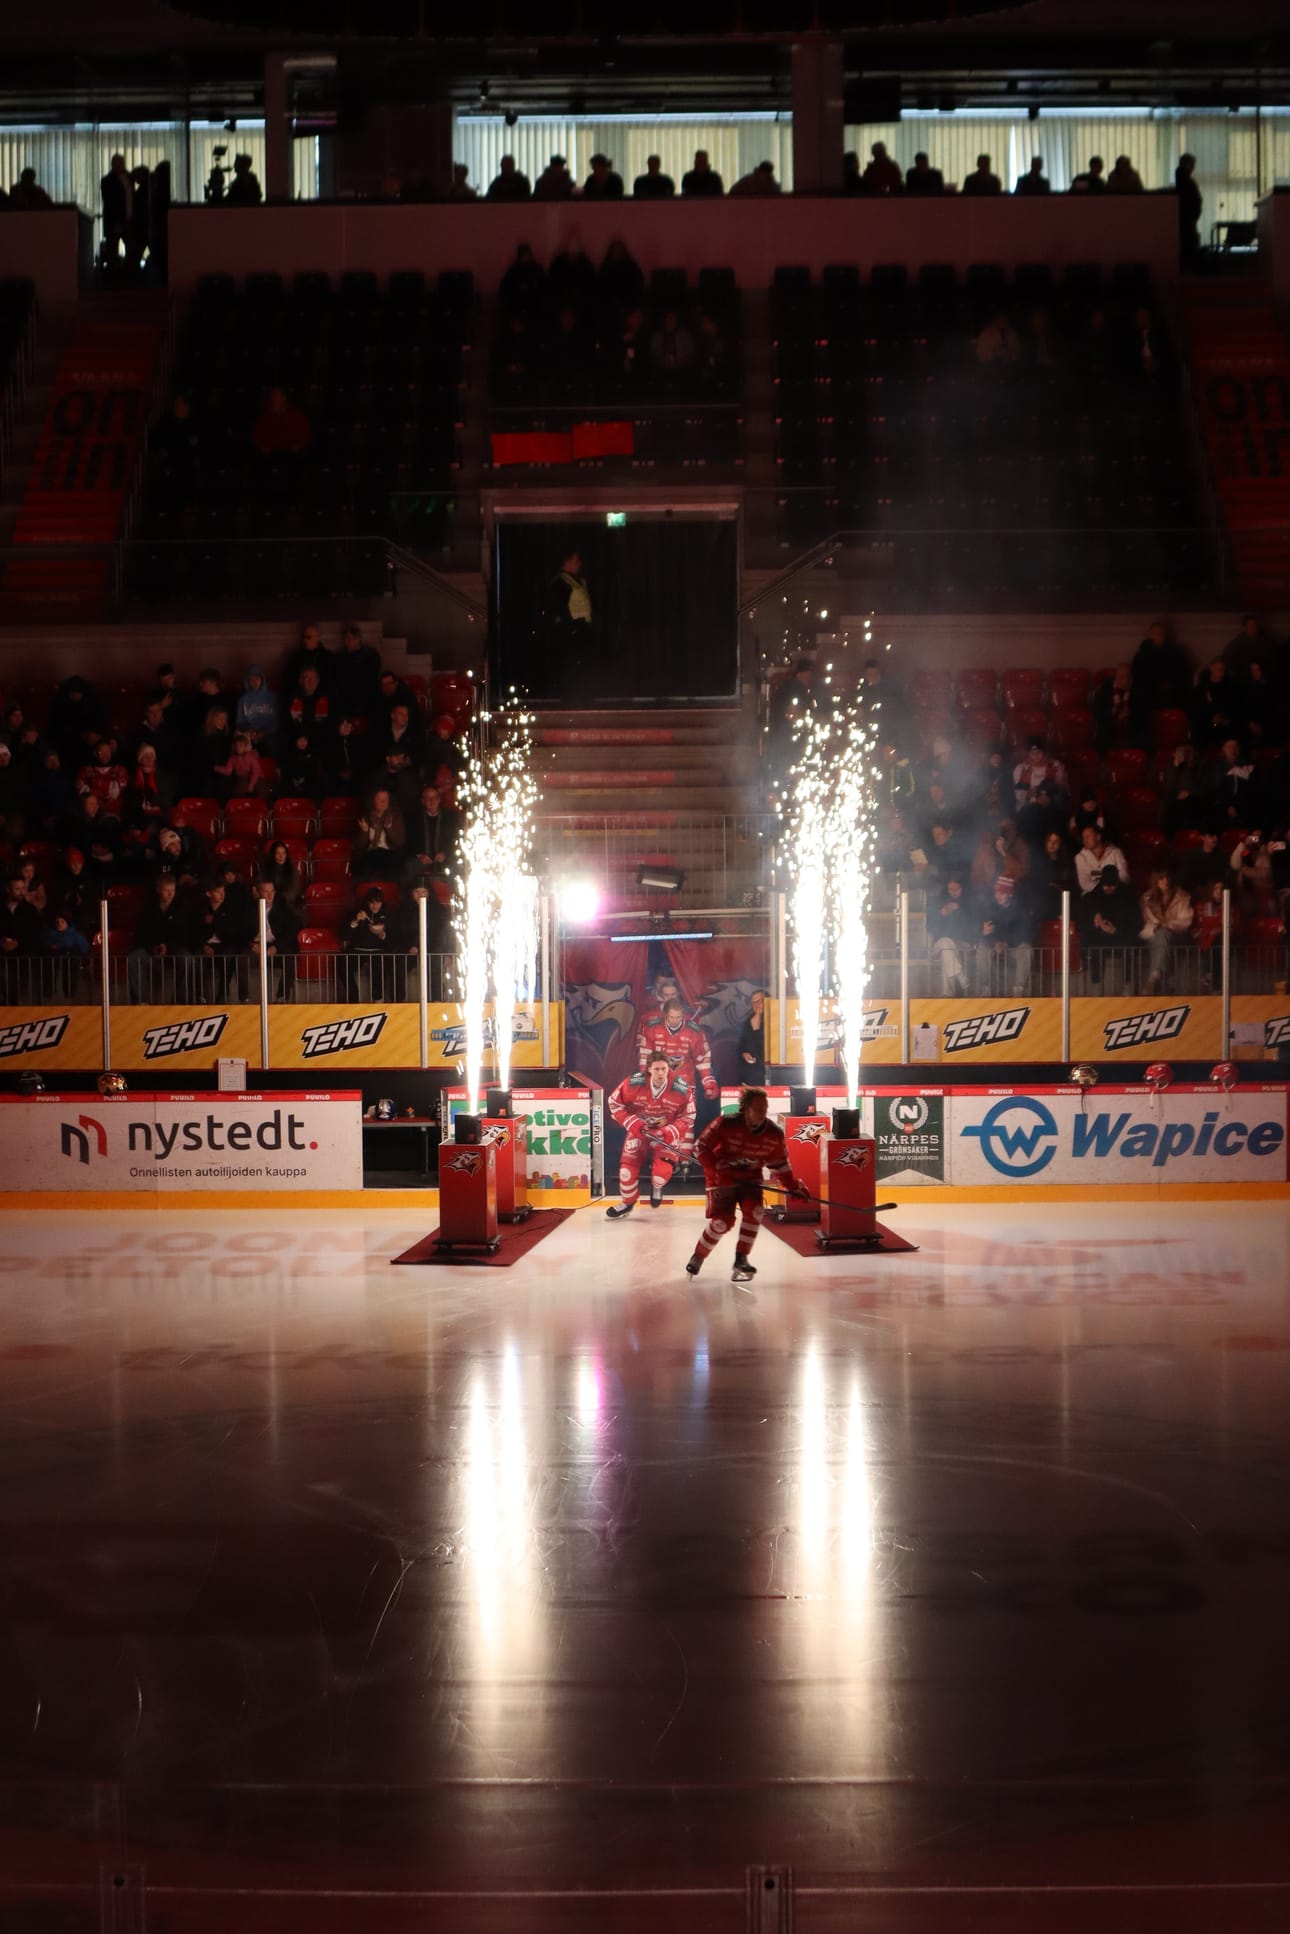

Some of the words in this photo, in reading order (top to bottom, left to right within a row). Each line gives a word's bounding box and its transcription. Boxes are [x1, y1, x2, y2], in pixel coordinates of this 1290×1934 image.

[0, 1014, 70, 1057] EHO
[144, 1014, 228, 1058] TEHO
[302, 1013, 387, 1057] TEHO
[944, 1008, 1031, 1052] TEHO
[1104, 1006, 1191, 1050] TEHO
[129, 1109, 318, 1159] nystedt.
[879, 1133, 939, 1145] NÄRPES
[1071, 1111, 1284, 1166] Wapice
[130, 1166, 192, 1178] Onnellisten
[195, 1166, 262, 1180] autoilijoiden
[266, 1166, 307, 1180] kauppa
